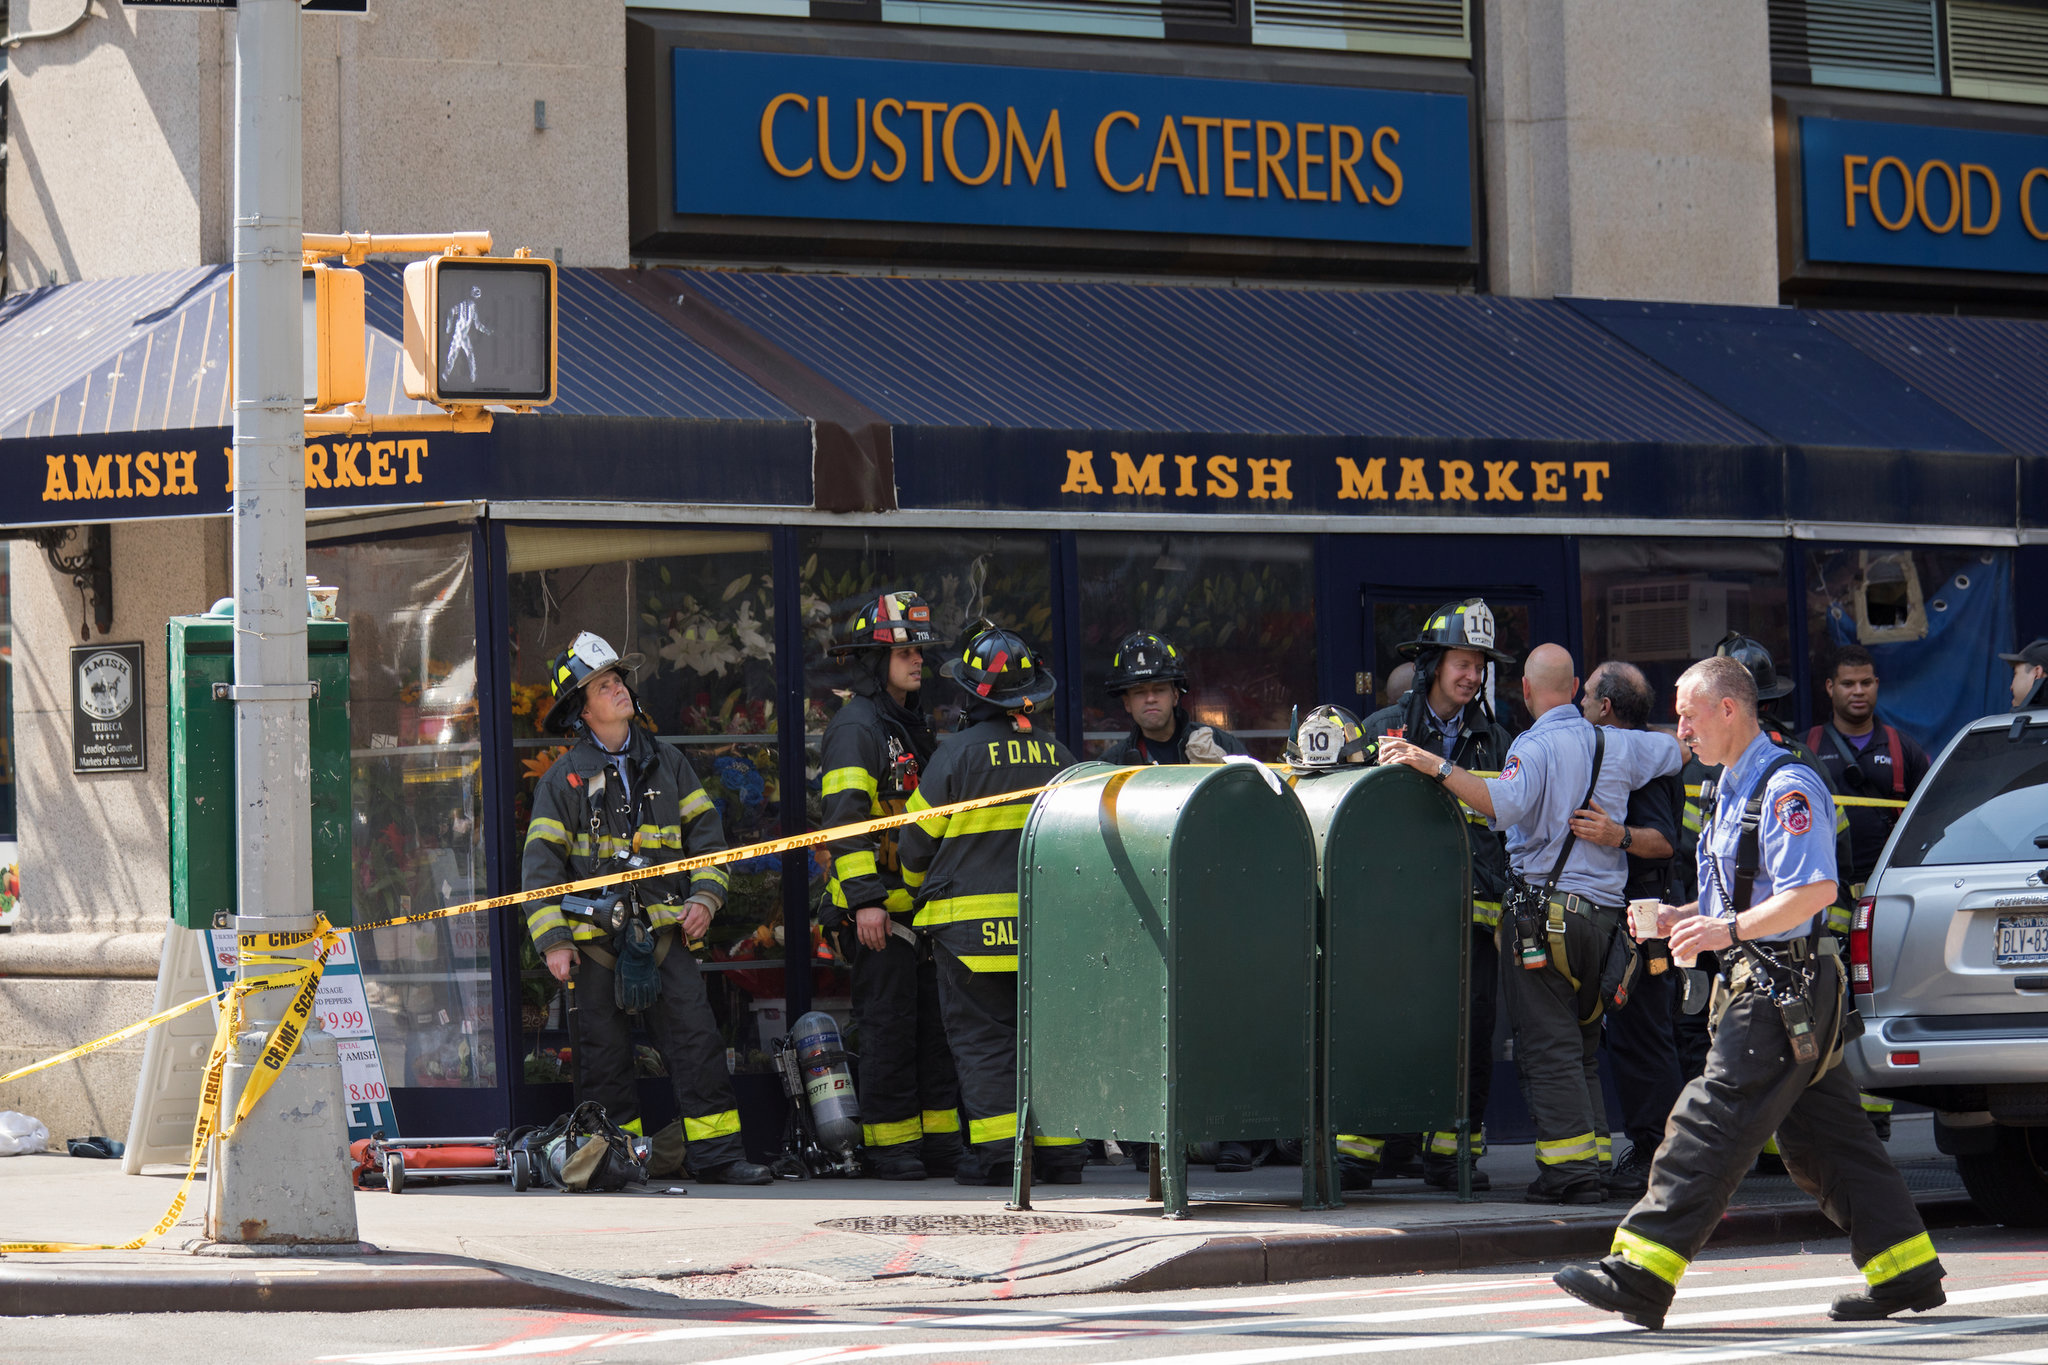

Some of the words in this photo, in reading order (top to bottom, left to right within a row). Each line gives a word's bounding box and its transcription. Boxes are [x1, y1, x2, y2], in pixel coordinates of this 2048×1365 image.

[760, 92, 1067, 188] CUSTOM
[1094, 110, 1403, 206] CATERERS
[1843, 154, 2001, 236] FOOD
[42, 450, 198, 502] AMISH
[224, 438, 428, 493] RKET
[1060, 449, 1293, 500] AMISH
[1335, 456, 1610, 501] MARKET
[1471, 616, 1492, 636] 10
[592, 643, 606, 656] 4
[84, 658, 129, 677] AMISH
[1137, 652, 1146, 666] 4
[84, 696, 129, 714] MARKET
[91, 722, 122, 732] TRIBECA
[83, 744, 106, 756] Leading
[107, 743, 133, 753] Gourmet
[1309, 732, 1329, 751] 10
[80, 757, 102, 767] Markets
[103, 756, 109, 765] of
[110, 756, 119, 765] the
[120, 755, 138, 765] World
[317, 987, 343, 995] AUSAGE
[315, 997, 324, 1006] ND
[325, 997, 353, 1005] PEPPERS
[263, 1020, 300, 1071] CRIME
[293, 971, 321, 1019] SCENE
[346, 1050, 376, 1061] AMISH
